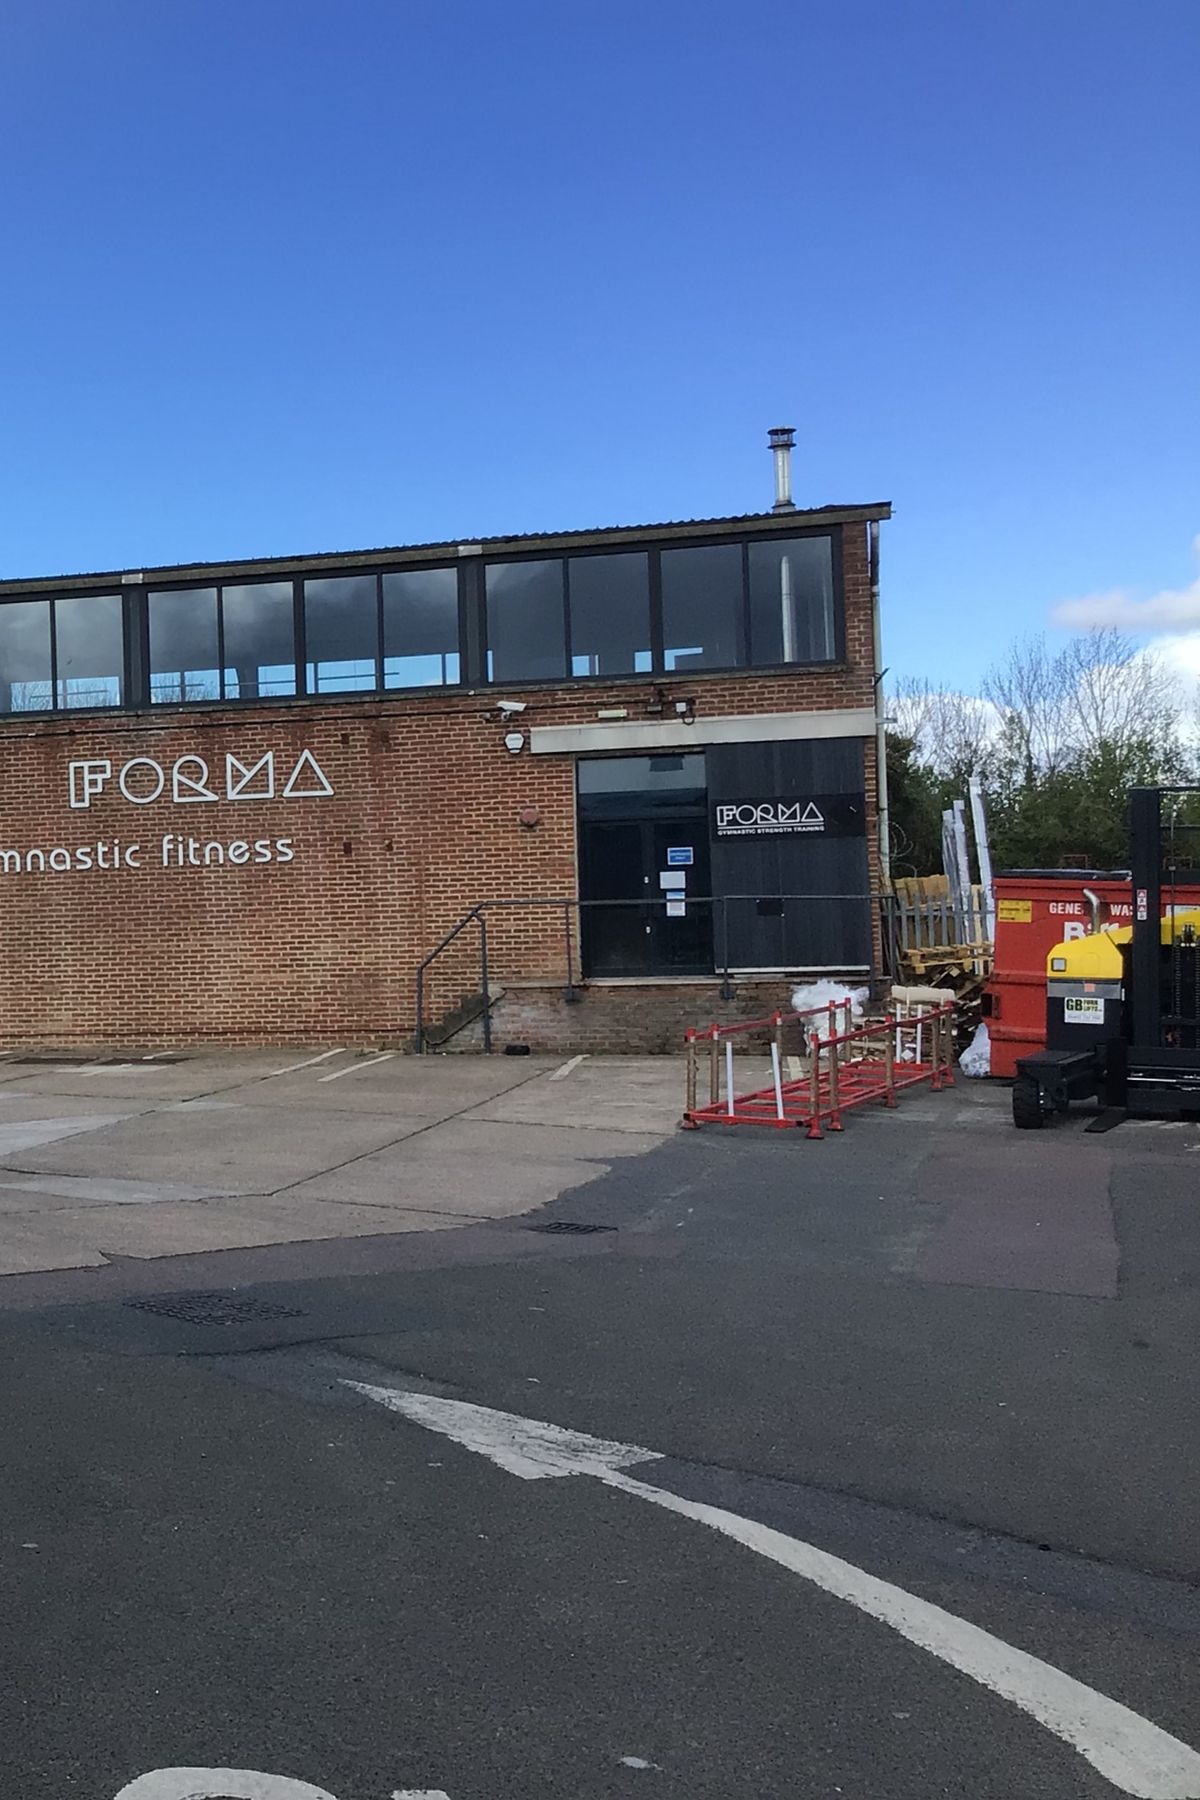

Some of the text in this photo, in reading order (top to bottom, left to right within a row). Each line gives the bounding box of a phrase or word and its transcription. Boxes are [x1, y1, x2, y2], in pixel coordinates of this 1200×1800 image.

[69, 748, 335, 809] FORMA
[716, 801, 824, 826] FORMA
[717, 828, 756, 836] GYMNASTIC
[162, 833, 295, 867] fitness
[1049, 902, 1085, 915] GENE
[1066, 998, 1083, 1011] GB
